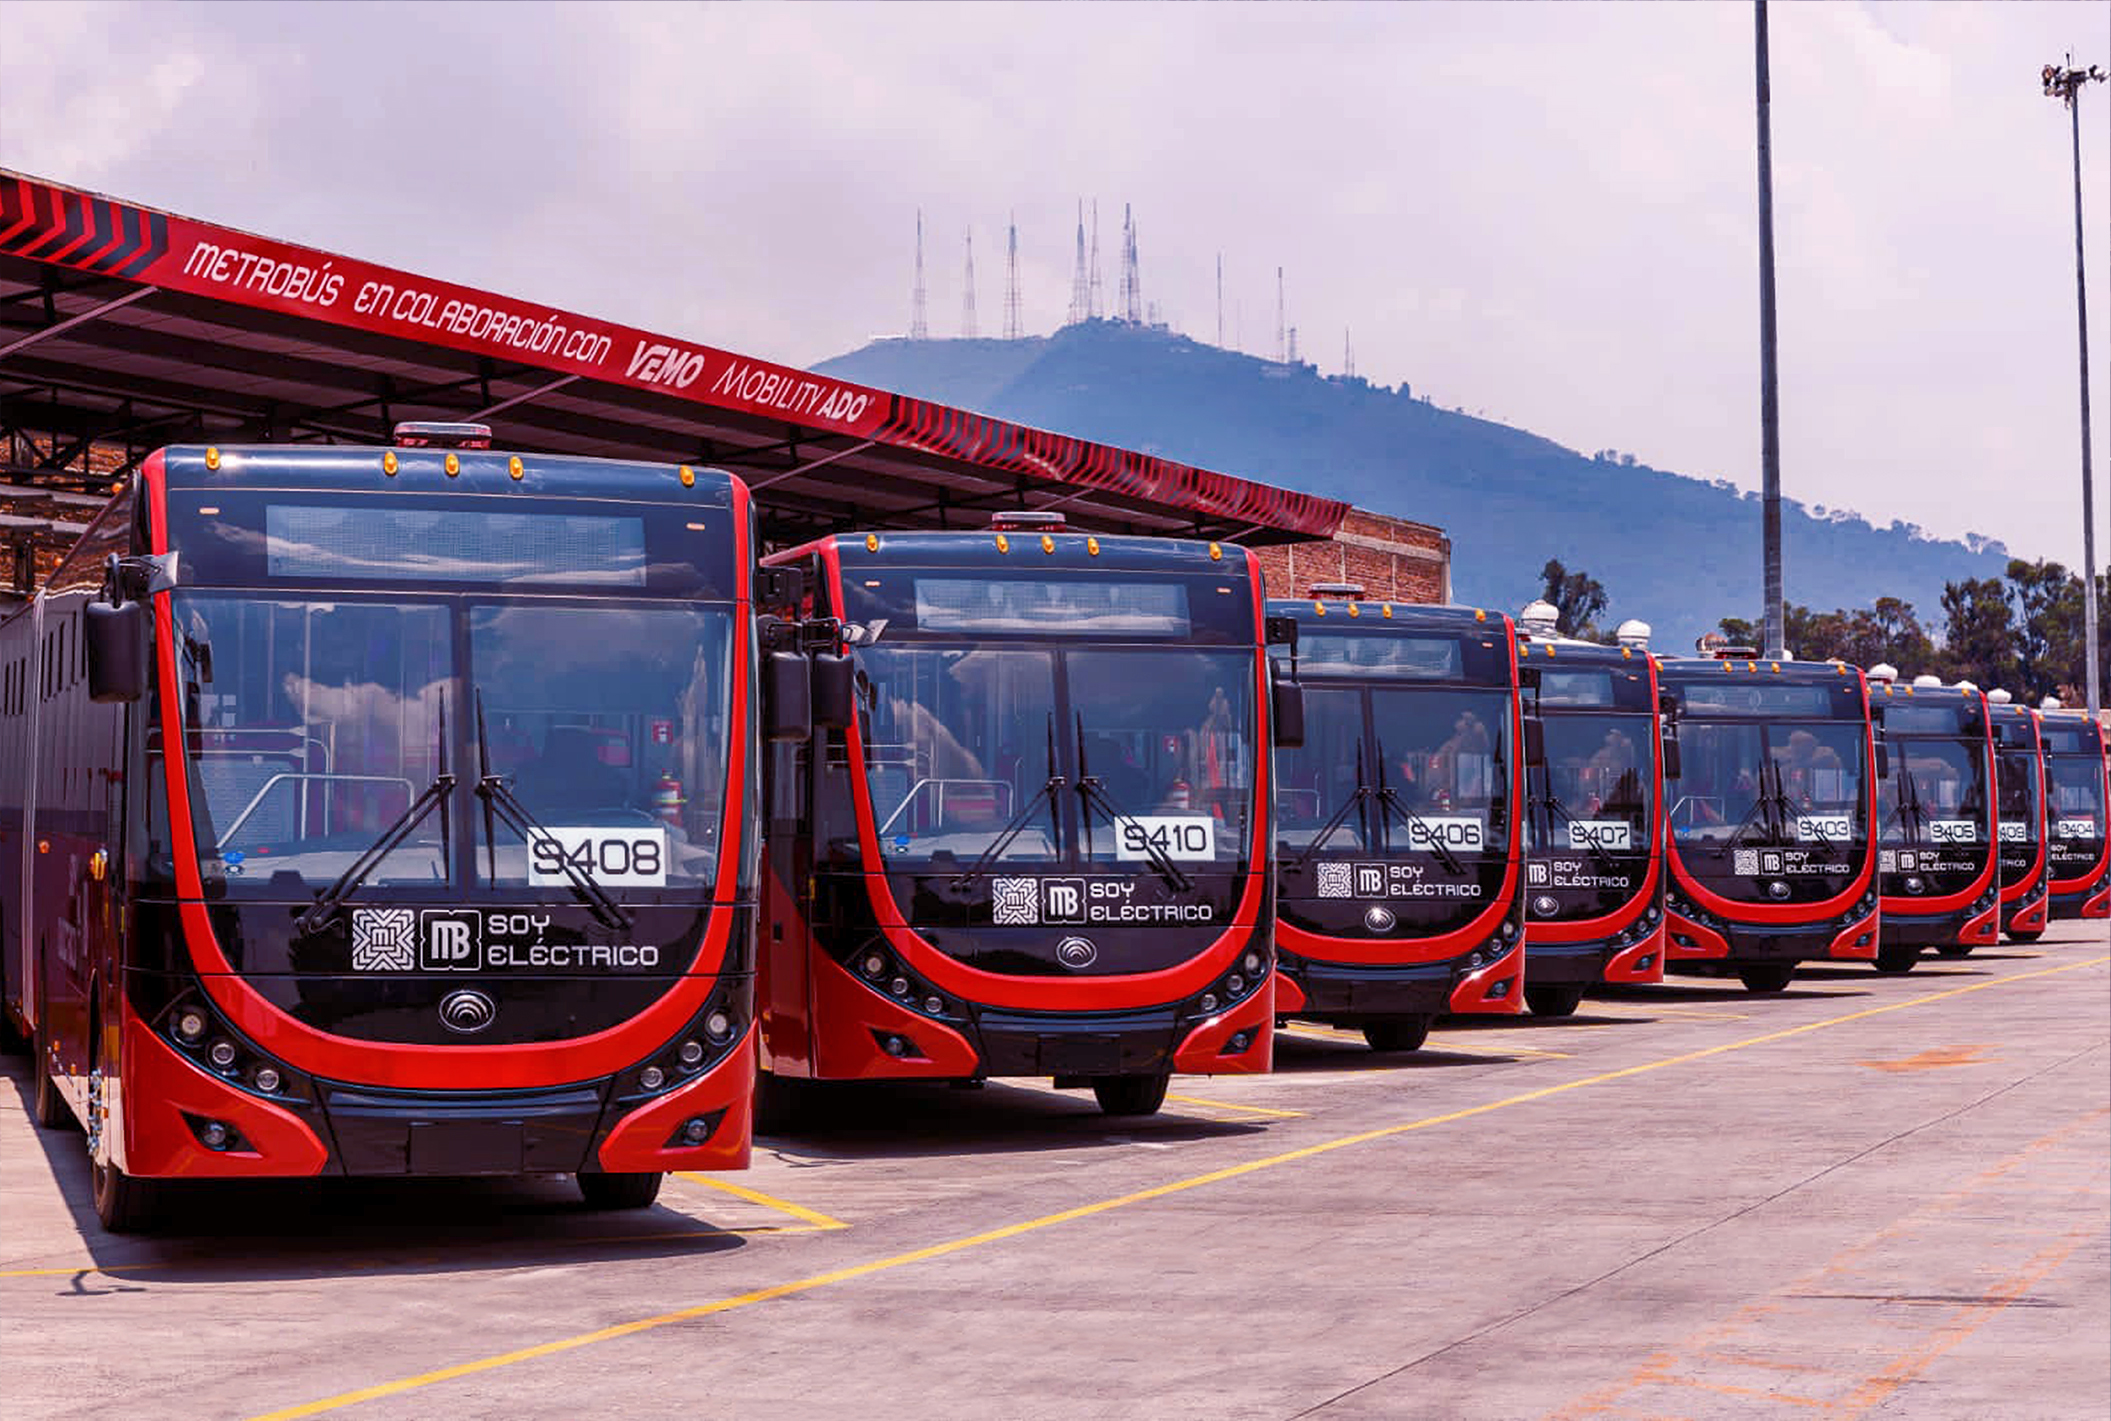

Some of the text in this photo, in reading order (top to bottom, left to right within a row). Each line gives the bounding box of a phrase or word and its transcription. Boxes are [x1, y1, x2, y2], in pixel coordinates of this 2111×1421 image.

[183, 241, 344, 306] METROBÚS
[354, 281, 394, 314] EN
[392, 289, 568, 354] COLABORACIÓN
[563, 330, 611, 365] CON
[624, 340, 704, 389] VEMO
[1123, 824, 1207, 852] 9410
[1411, 823, 1481, 844] 9406
[1572, 825, 1628, 845] 9407
[1800, 820, 1848, 836] 9403
[1932, 824, 1975, 838] 9405
[533, 838, 661, 876] 9408
[1553, 861, 1582, 873] SOY
[1785, 852, 1810, 863] SOY
[1390, 866, 1424, 878] SOY
[1553, 873, 1630, 887] ELÉCTRICO
[1090, 882, 1135, 898] SOY
[1390, 880, 1482, 896] ELÉCTRICO
[1050, 886, 1079, 916] MB
[1090, 900, 1213, 921] ELÉCTRICO
[488, 914, 551, 935] SOY
[431, 920, 471, 960] MB
[488, 939, 660, 967] ELÉCTRICO
